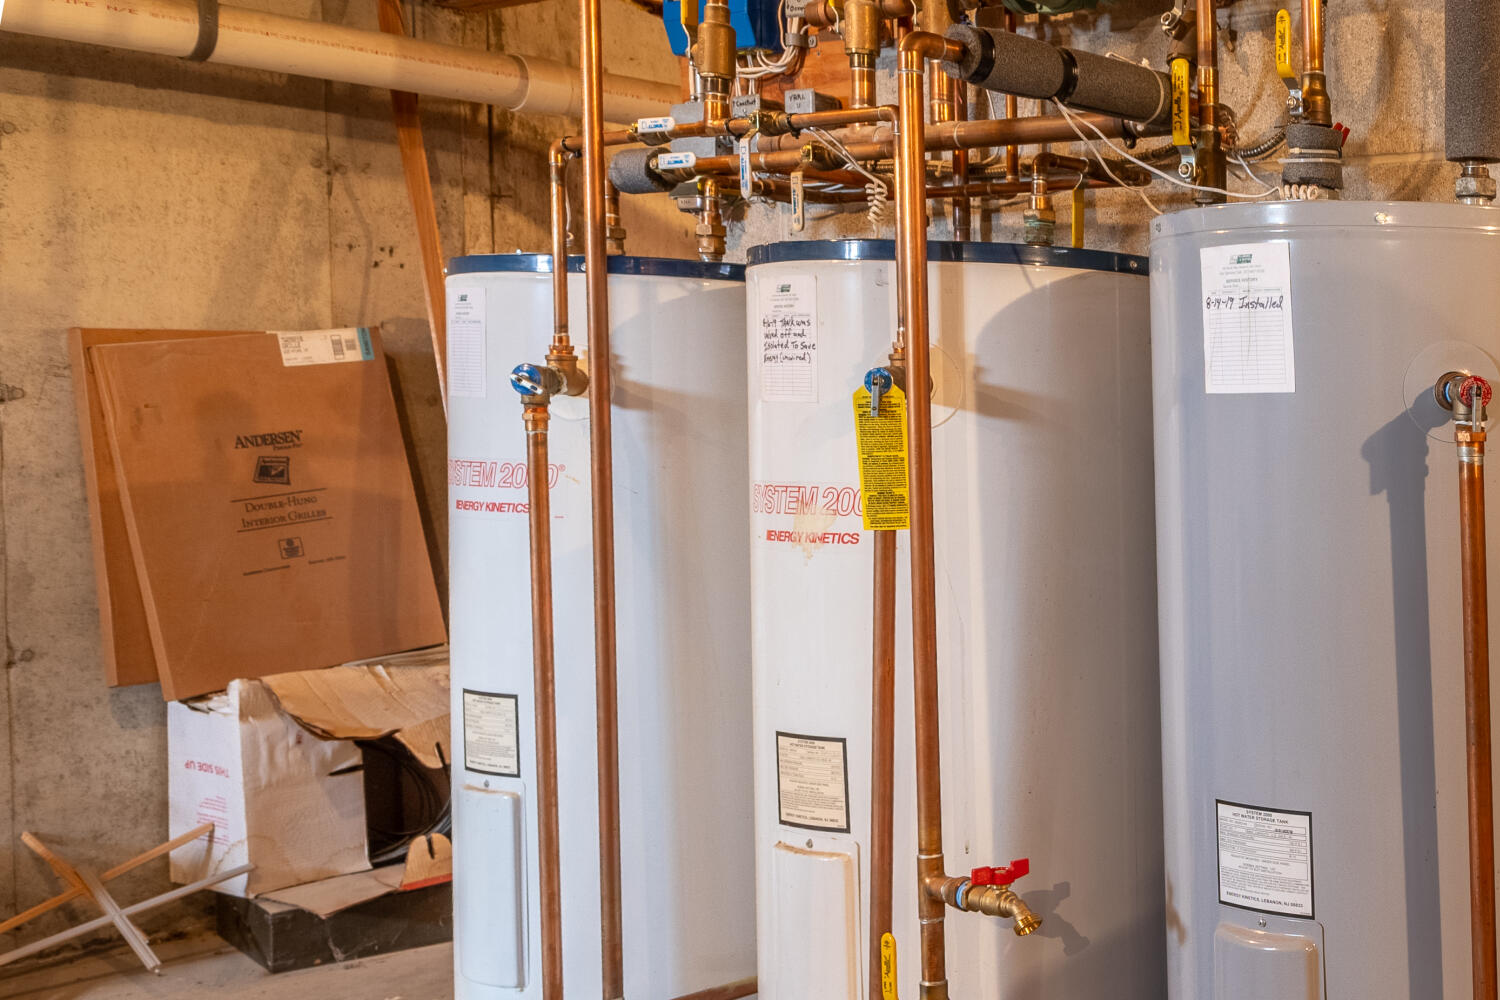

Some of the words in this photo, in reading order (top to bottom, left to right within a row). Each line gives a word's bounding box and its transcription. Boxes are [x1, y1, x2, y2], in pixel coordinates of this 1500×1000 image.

[1239, 295, 1283, 311] Installed
[235, 431, 300, 448] ANDERSEN
[485, 502, 530, 513] KINETICS
[753, 484, 819, 515] SYSTEM
[767, 530, 802, 543] ENERGY
[804, 531, 860, 544] KINETICS
